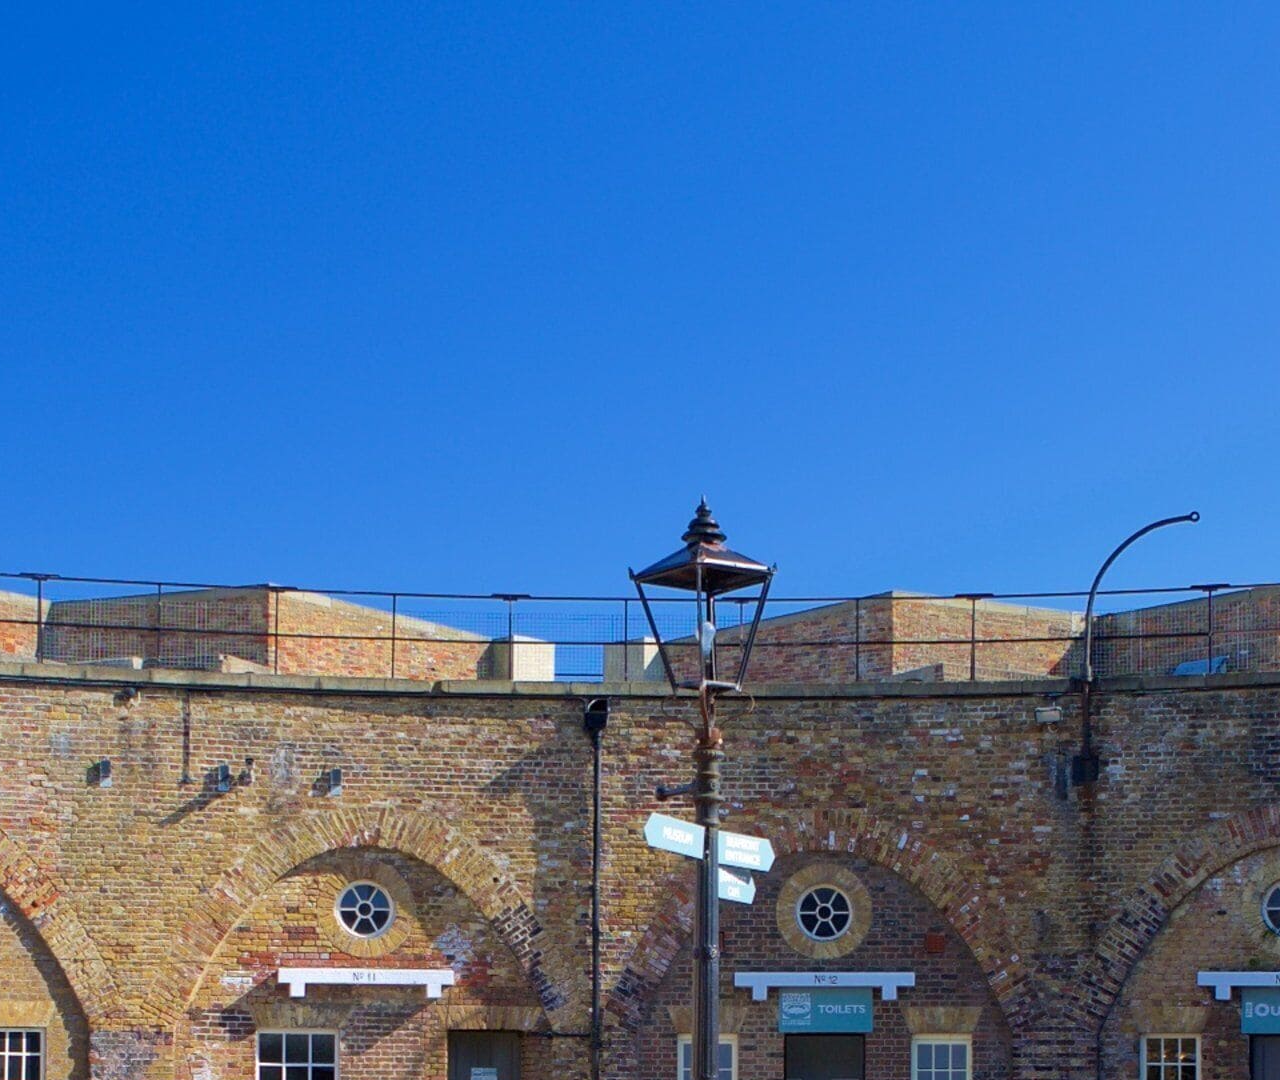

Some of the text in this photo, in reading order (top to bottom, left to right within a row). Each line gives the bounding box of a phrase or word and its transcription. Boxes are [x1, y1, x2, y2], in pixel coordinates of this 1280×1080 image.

[367, 972, 376, 982] 11
[828, 975, 839, 985] 12
[817, 1004, 867, 1015] TOILETS
